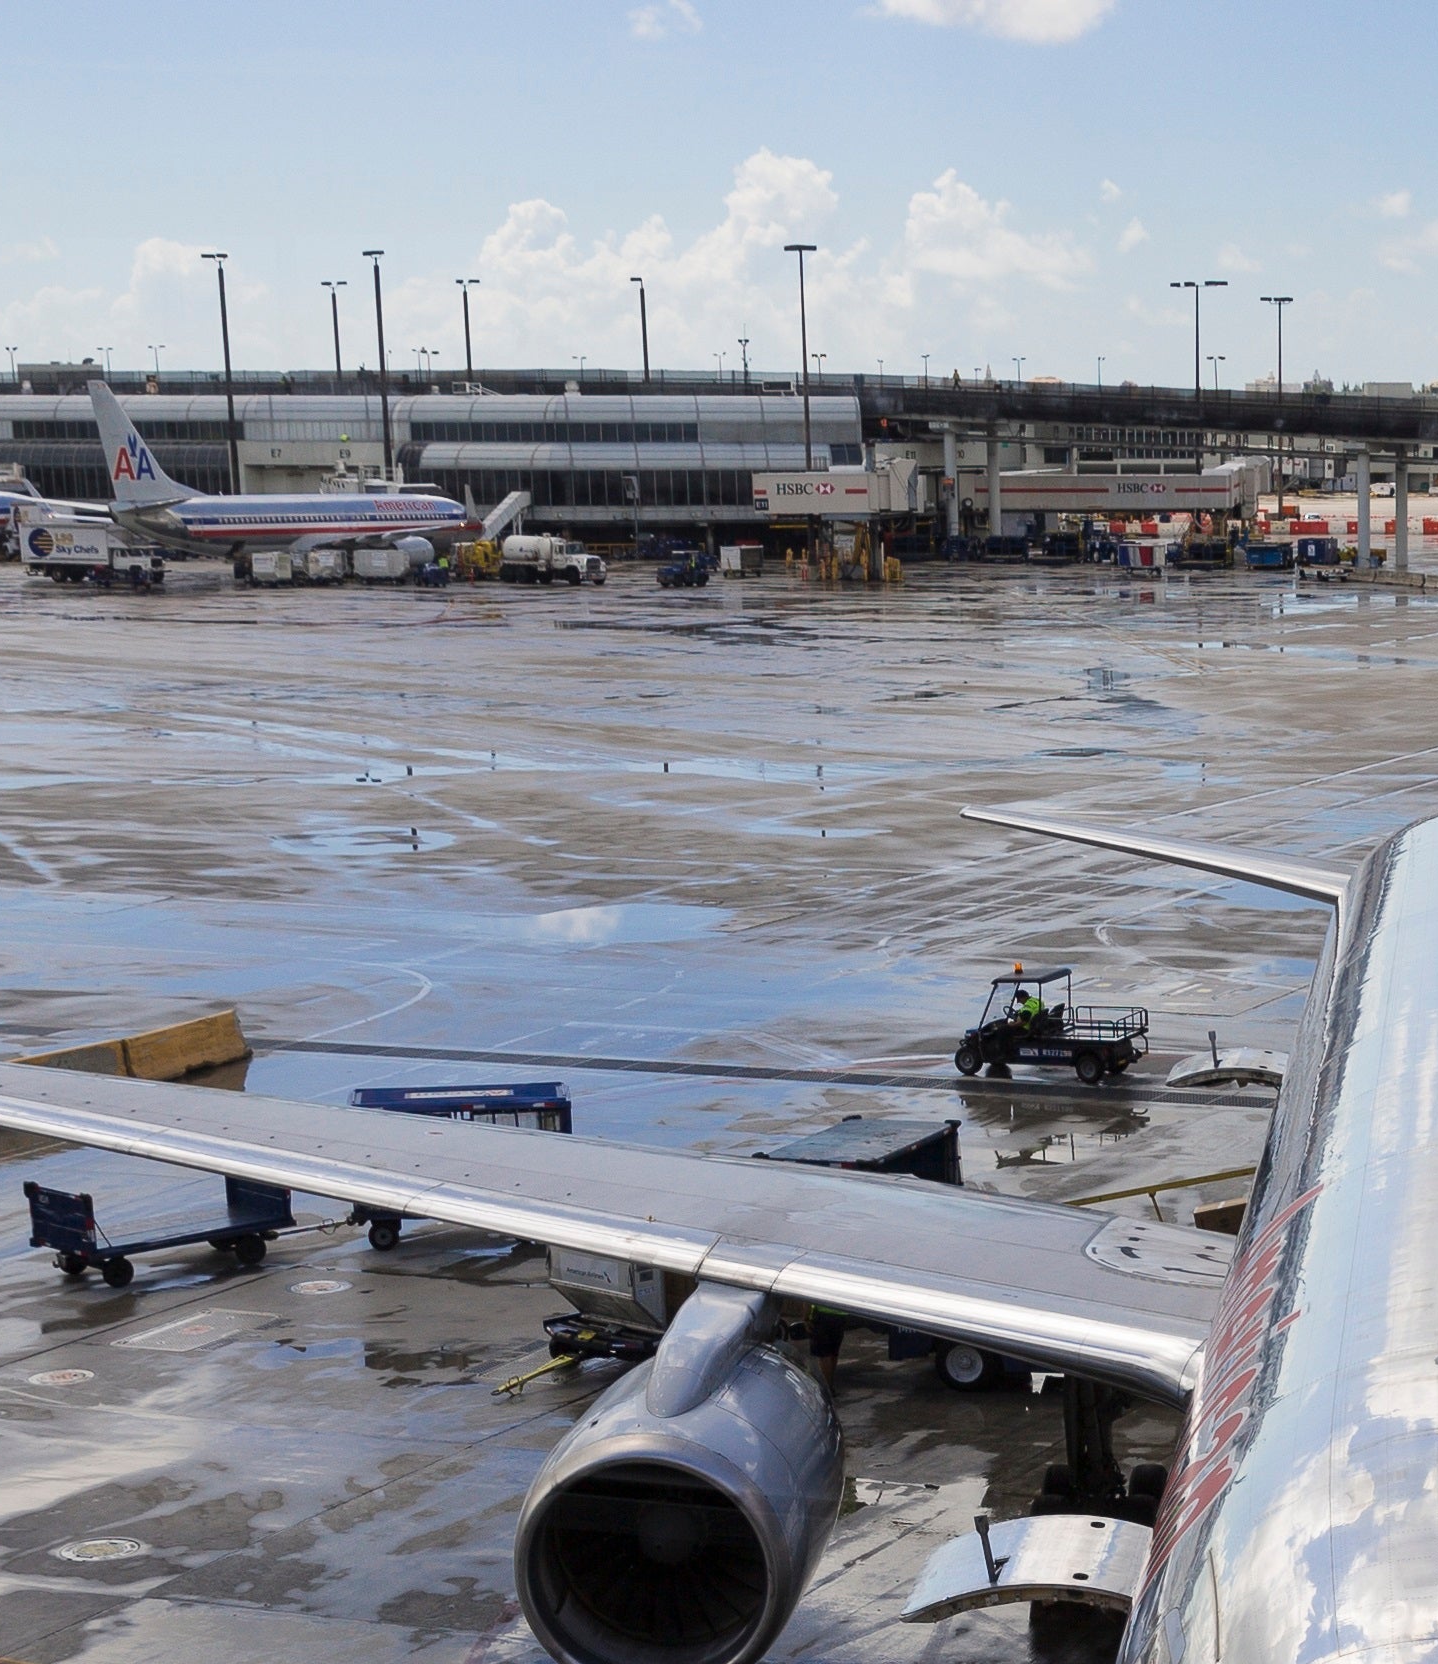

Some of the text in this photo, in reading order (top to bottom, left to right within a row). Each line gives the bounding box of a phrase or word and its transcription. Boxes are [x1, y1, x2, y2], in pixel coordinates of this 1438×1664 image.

[113, 447, 156, 480] AA
[775, 483, 813, 495] HSBC
[1117, 483, 1149, 493] HSBC
[374, 499, 437, 511] American
